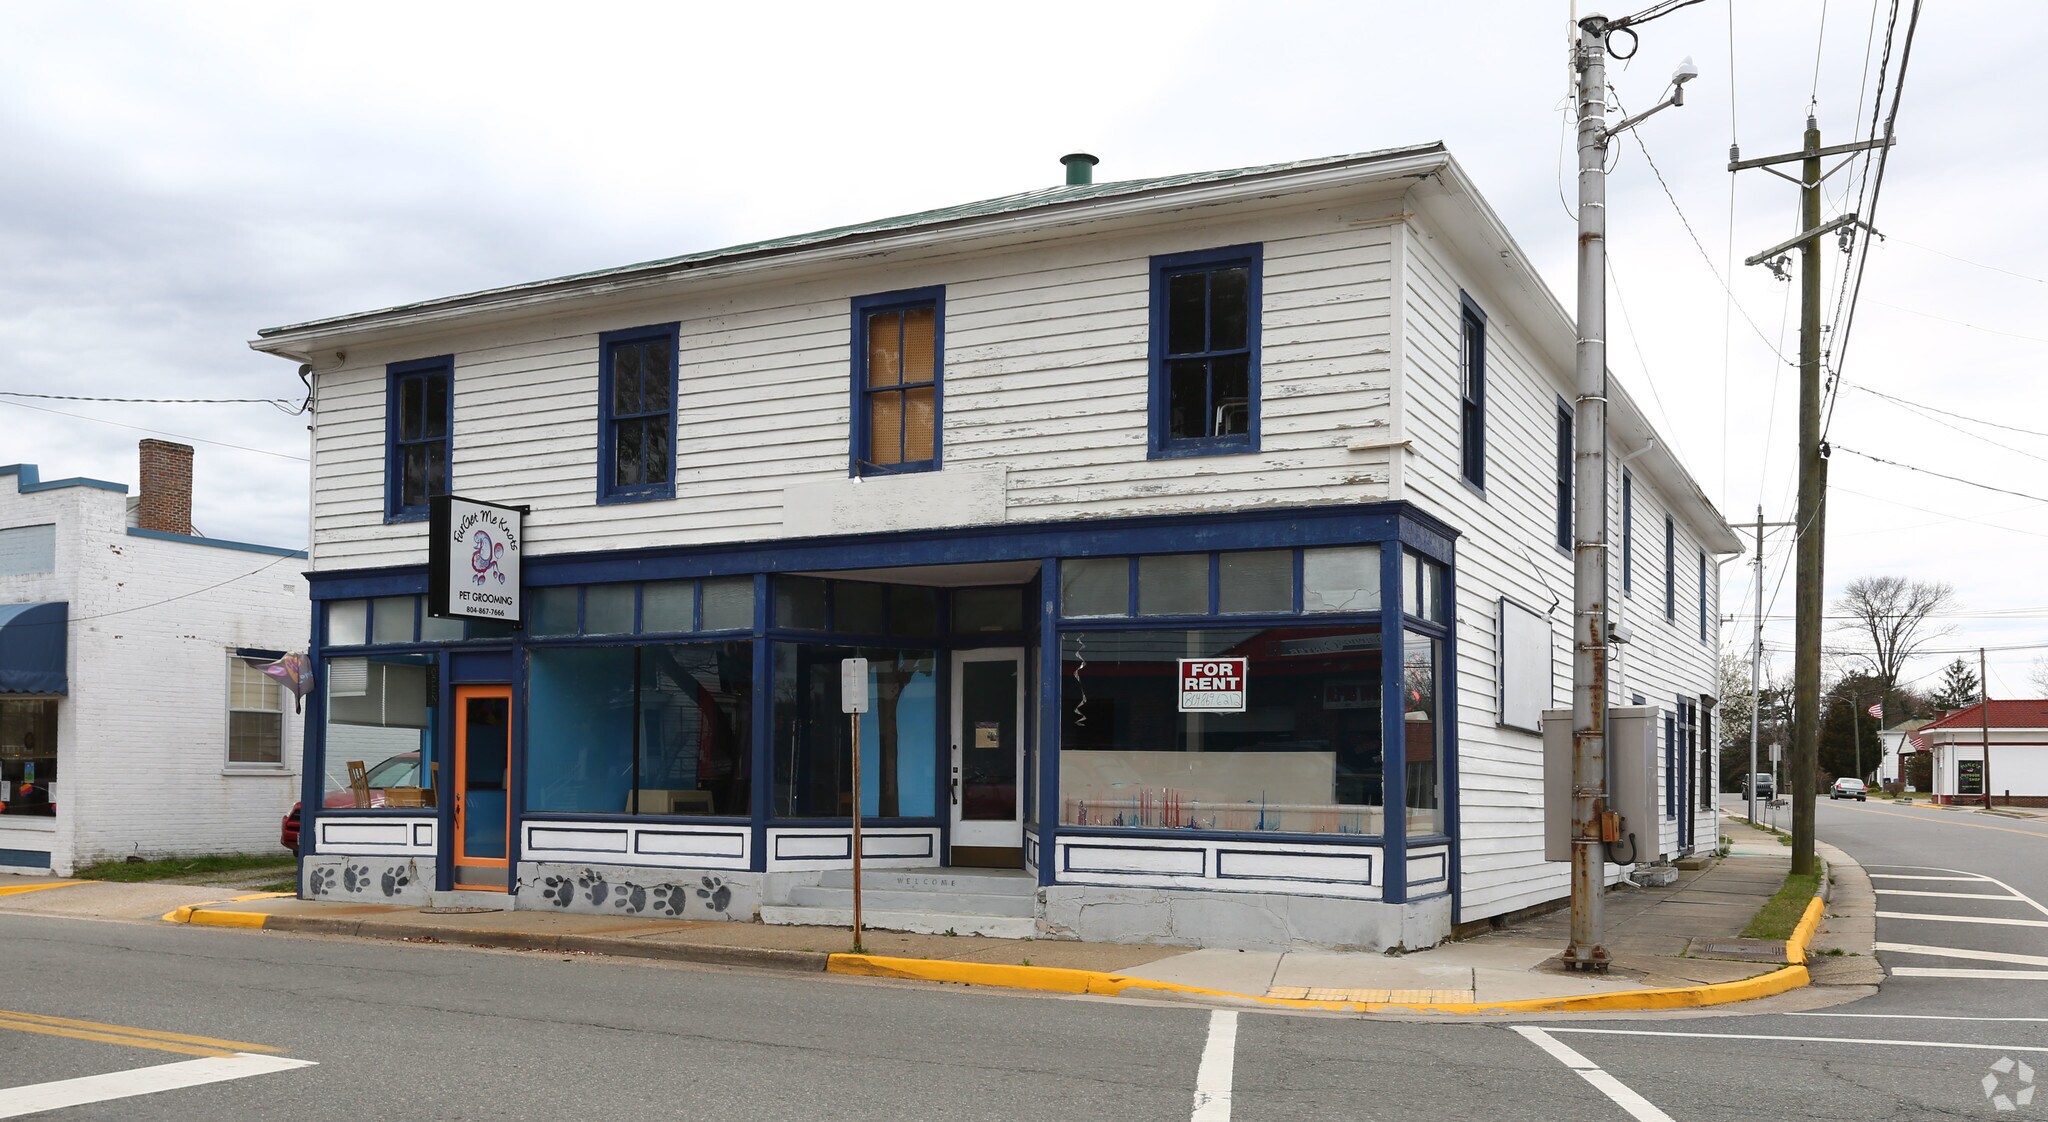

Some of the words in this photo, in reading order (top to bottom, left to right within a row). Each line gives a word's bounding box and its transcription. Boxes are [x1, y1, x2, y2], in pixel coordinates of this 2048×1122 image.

[480, 510, 497, 525] Me
[499, 517, 518, 551] Knots
[459, 590, 471, 600] PET
[472, 592, 513, 606] GROOMING
[1191, 663, 1233, 677] FOR
[1184, 677, 1241, 690] RENT
[897, 877, 956, 886] WELCOME
